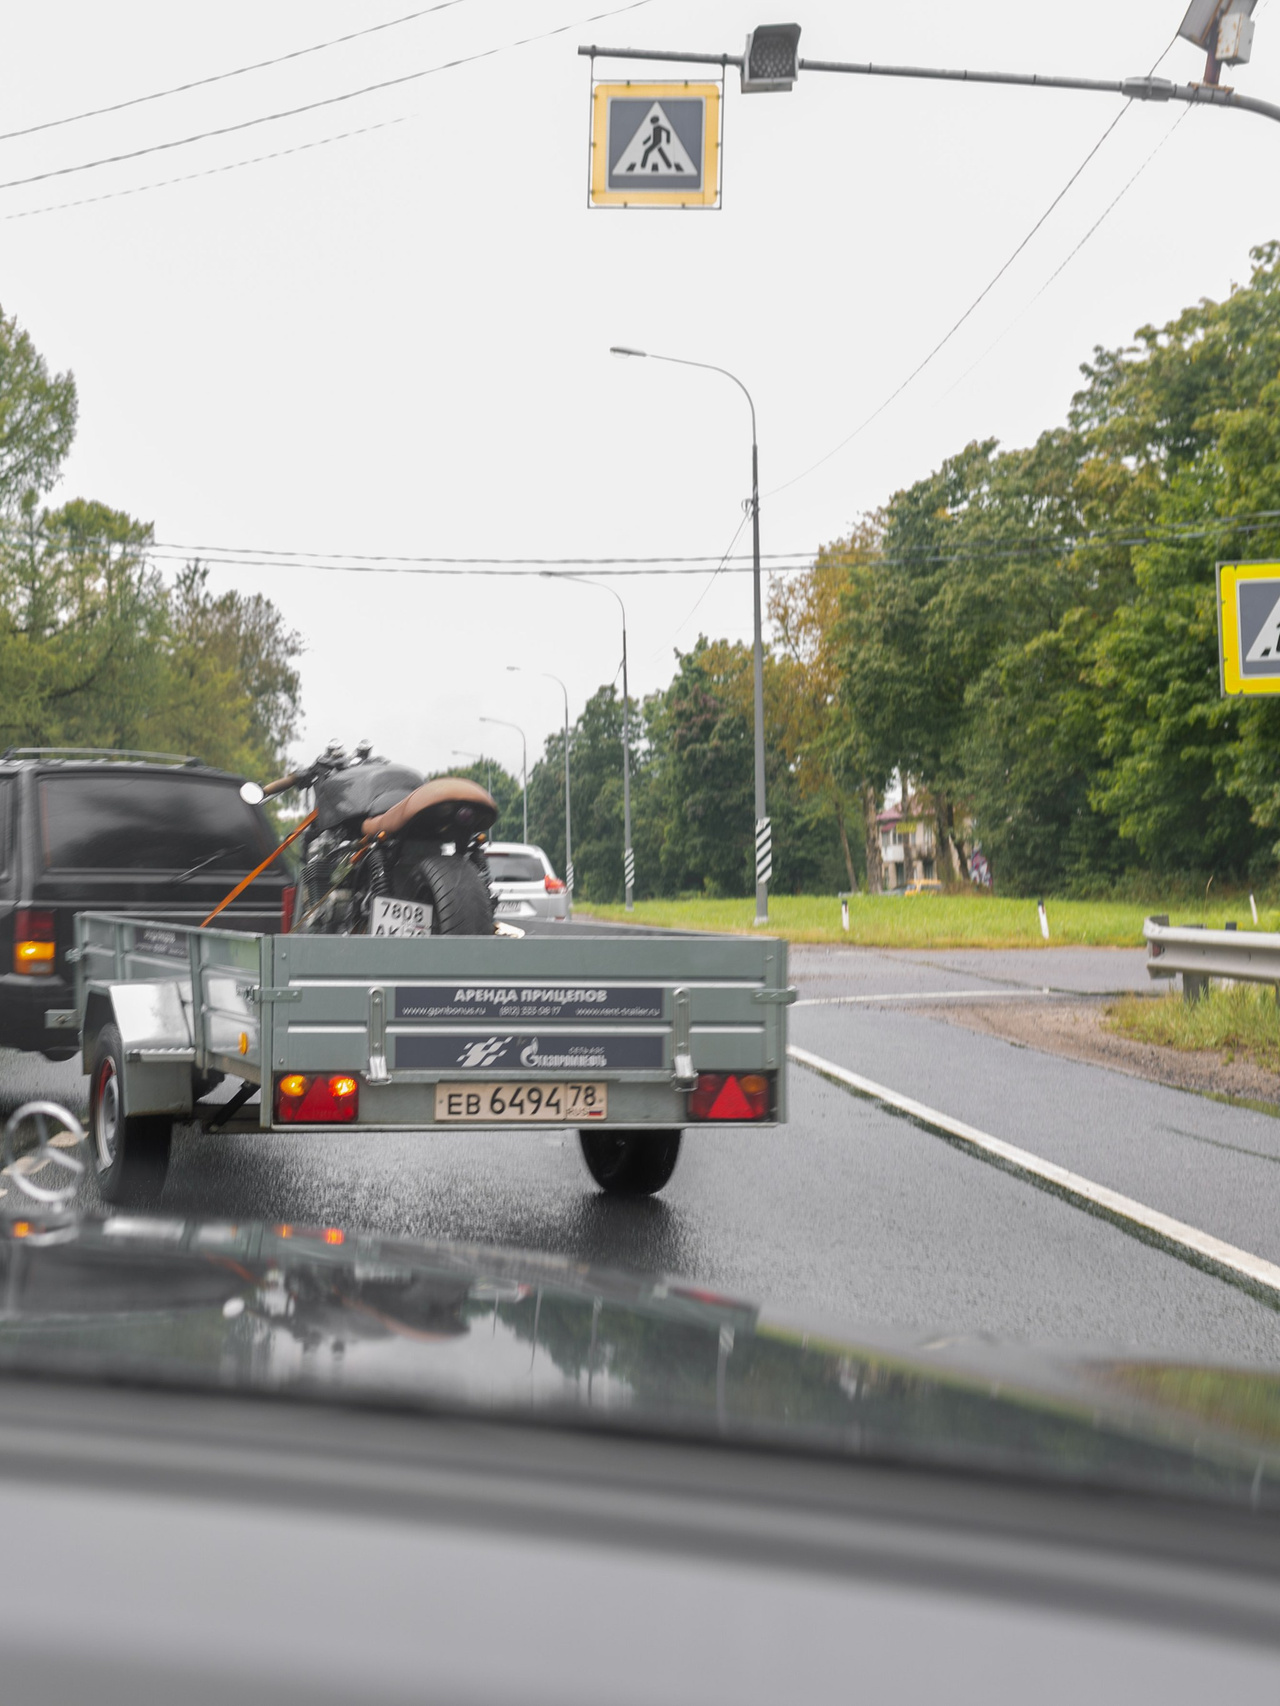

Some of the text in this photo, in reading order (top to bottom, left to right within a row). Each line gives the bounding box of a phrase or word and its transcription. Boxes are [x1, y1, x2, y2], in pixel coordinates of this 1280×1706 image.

[380, 900, 424, 922] 7808
[453, 989, 607, 1005] АРЕНДА ПРИЦЕПОВ
[499, 1006, 520, 1017] (812)
[521, 1006, 537, 1016] 333
[489, 1086, 561, 1116] 6494
[569, 1085, 596, 1107] 78
[566, 1107, 588, 1117] RUS
